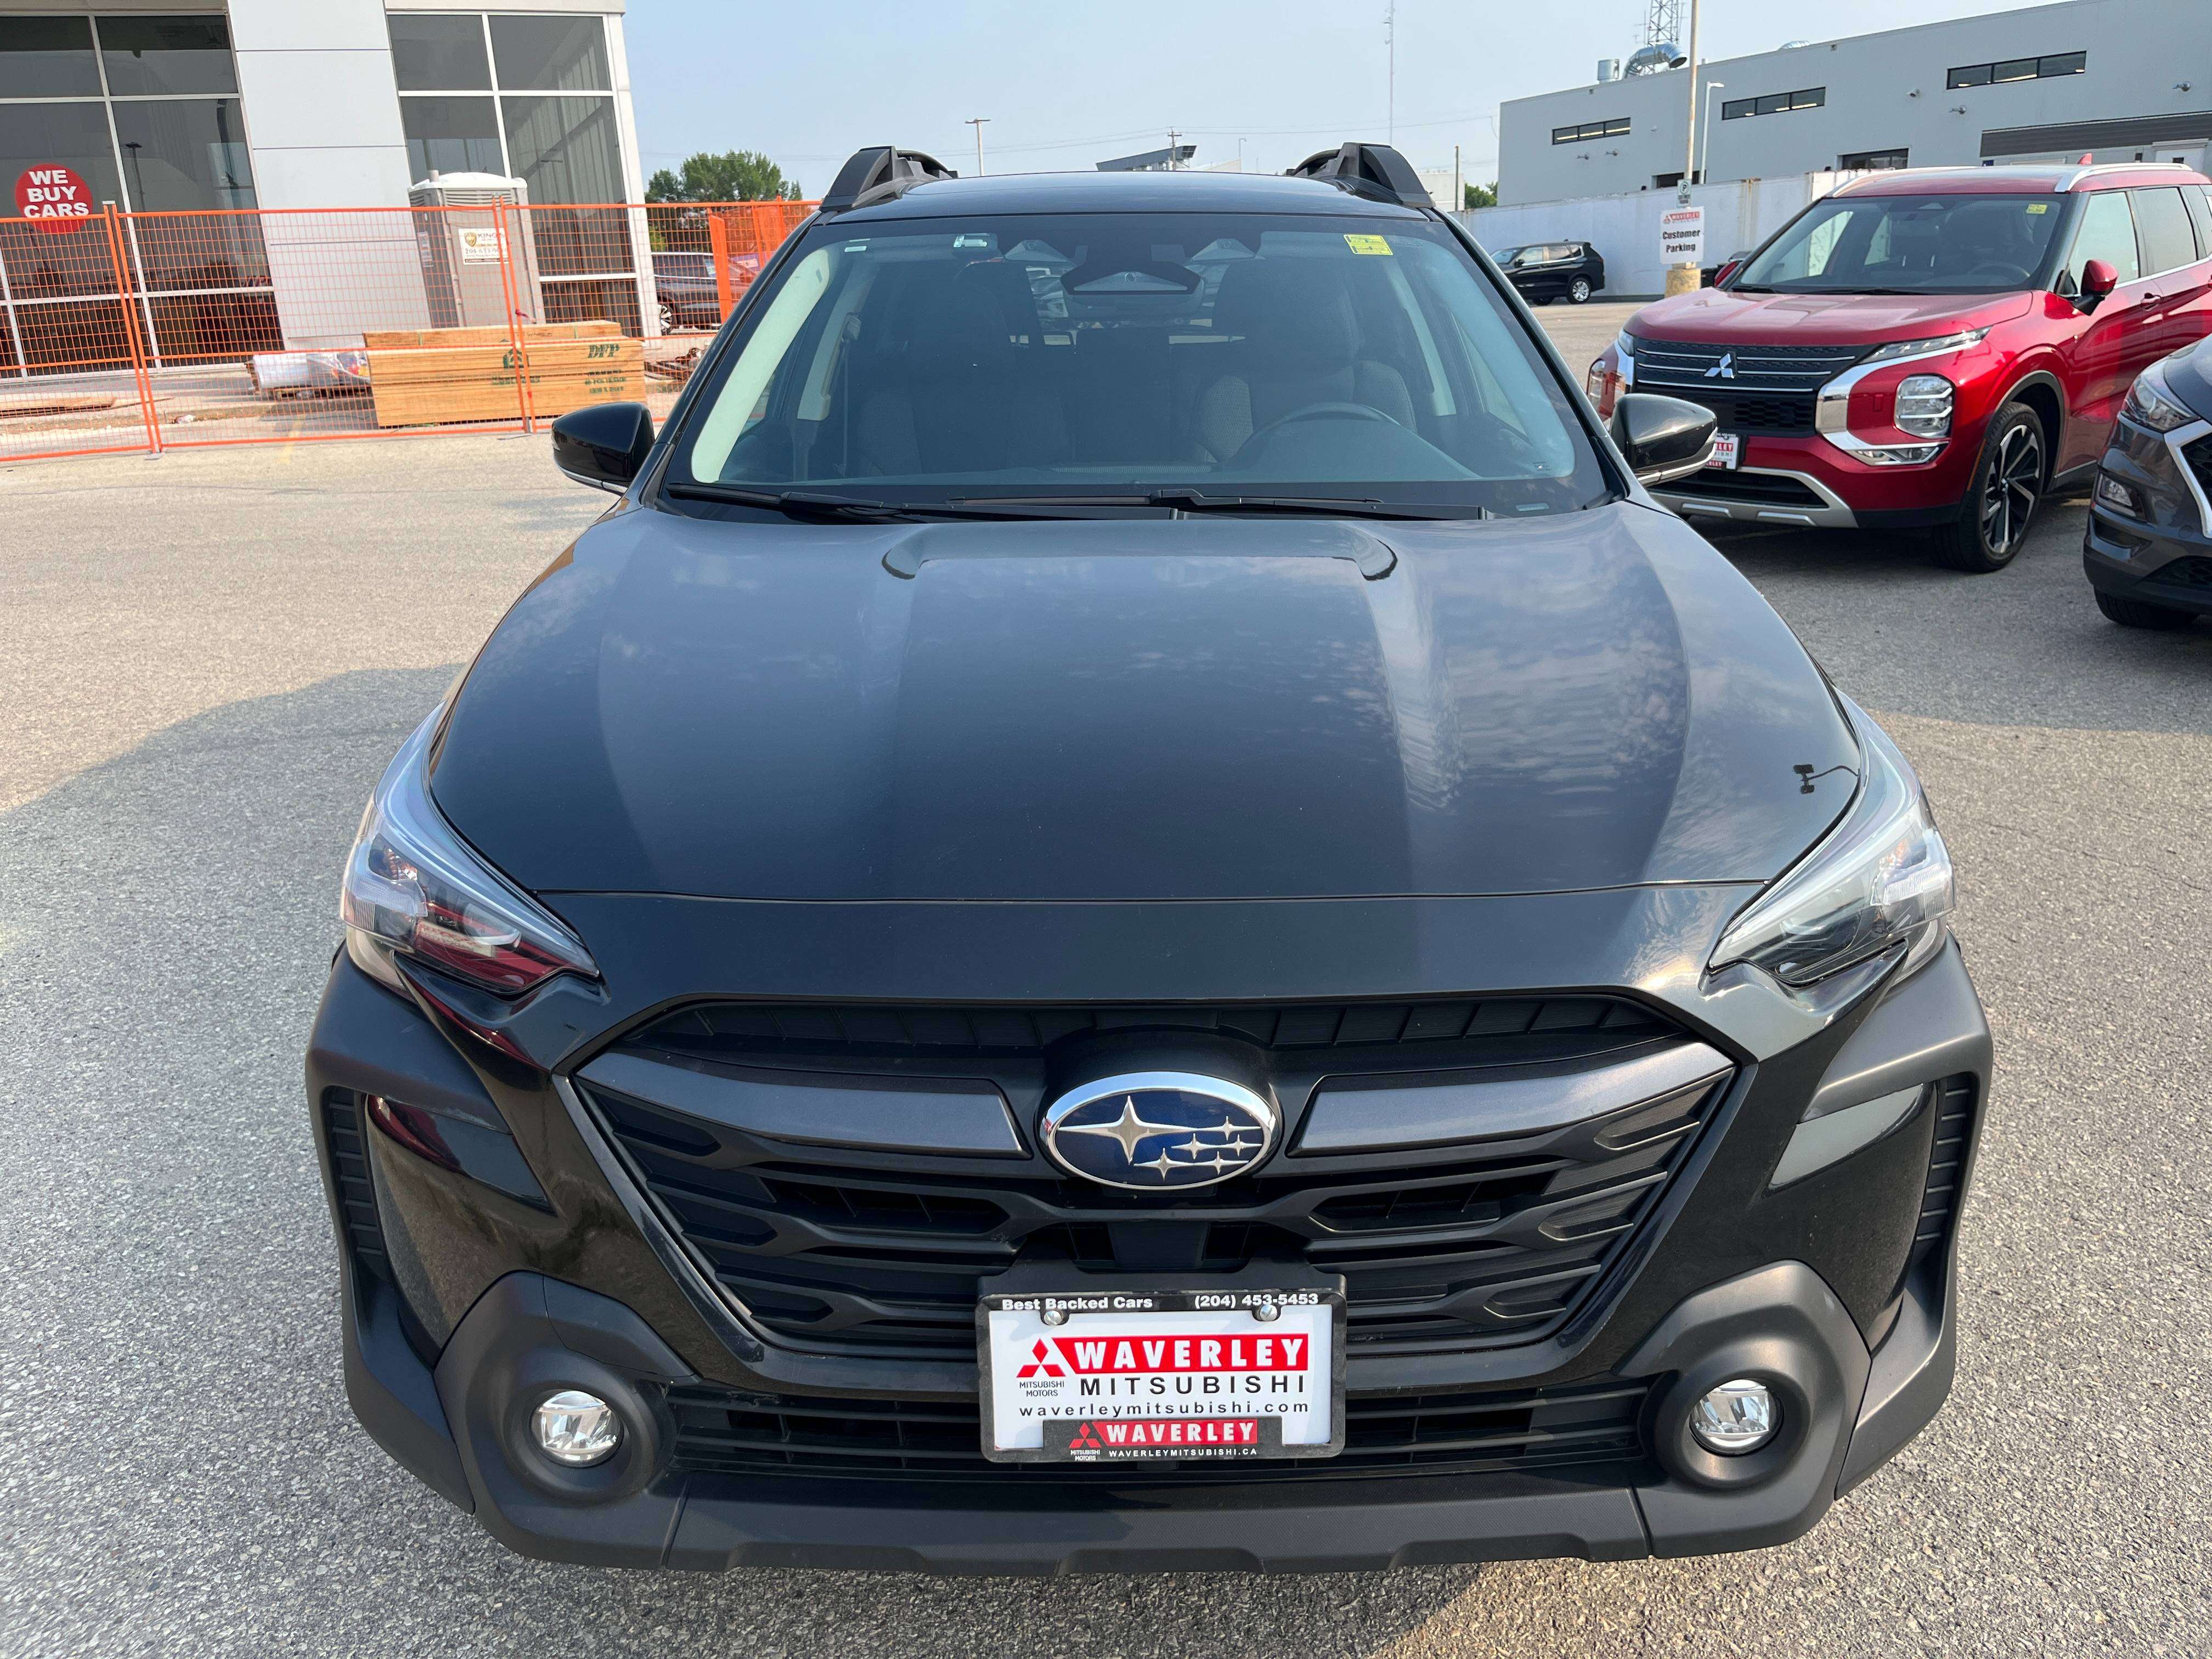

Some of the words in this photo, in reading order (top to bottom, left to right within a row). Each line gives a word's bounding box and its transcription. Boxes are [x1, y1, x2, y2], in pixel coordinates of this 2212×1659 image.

[28, 170, 69, 185] WE
[27, 186, 77, 202] BUY
[24, 202, 89, 218] CARS
[1663, 229, 1700, 239] Customer
[1666, 243, 1695, 252] Parking
[1002, 1298, 1041, 1311] Best
[1045, 1296, 1108, 1310] Backed
[1113, 1296, 1153, 1309] Cars
[1194, 1295, 1237, 1310] (204)
[1241, 1293, 1318, 1306] 453-5453
[1074, 1338, 1304, 1370] WAVERLEY
[1019, 1380, 1065, 1389] MITSUBISHI
[1080, 1375, 1304, 1396] MITSUBISHI
[1019, 1401, 1308, 1418] waverleymitsubishi.com
[1106, 1422, 1254, 1443] WAVERLEY
[1109, 1448, 1258, 1458] WAVERLEYMITSUBISHI.CA
